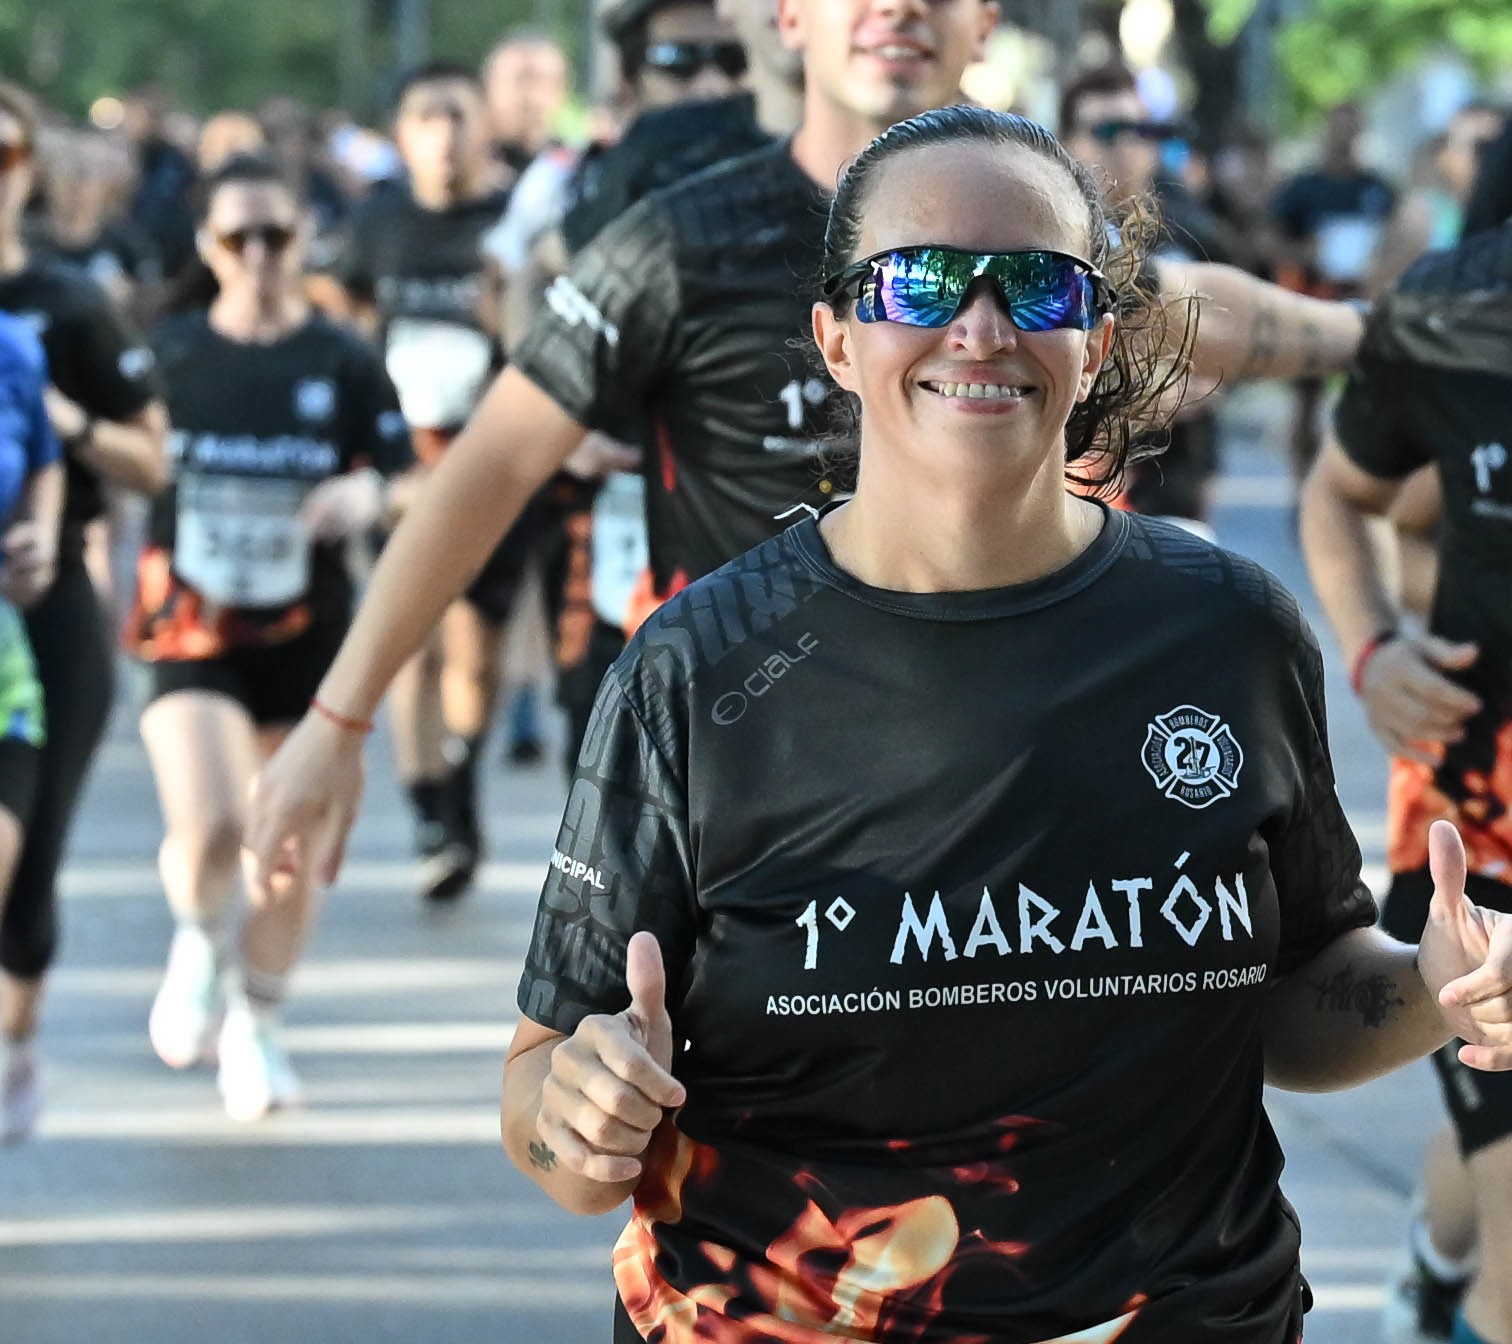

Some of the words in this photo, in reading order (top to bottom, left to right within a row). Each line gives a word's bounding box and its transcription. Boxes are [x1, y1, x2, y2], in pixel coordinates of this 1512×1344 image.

[1173, 736, 1210, 770] 27
[890, 851, 1254, 965] MARATÓN
[765, 986, 901, 1016] ASOCIACIÓN
[909, 981, 1038, 1009] BOMBEROS
[1044, 971, 1198, 1001] VOLUNTARIOS
[1202, 963, 1267, 989] ROSARIO
